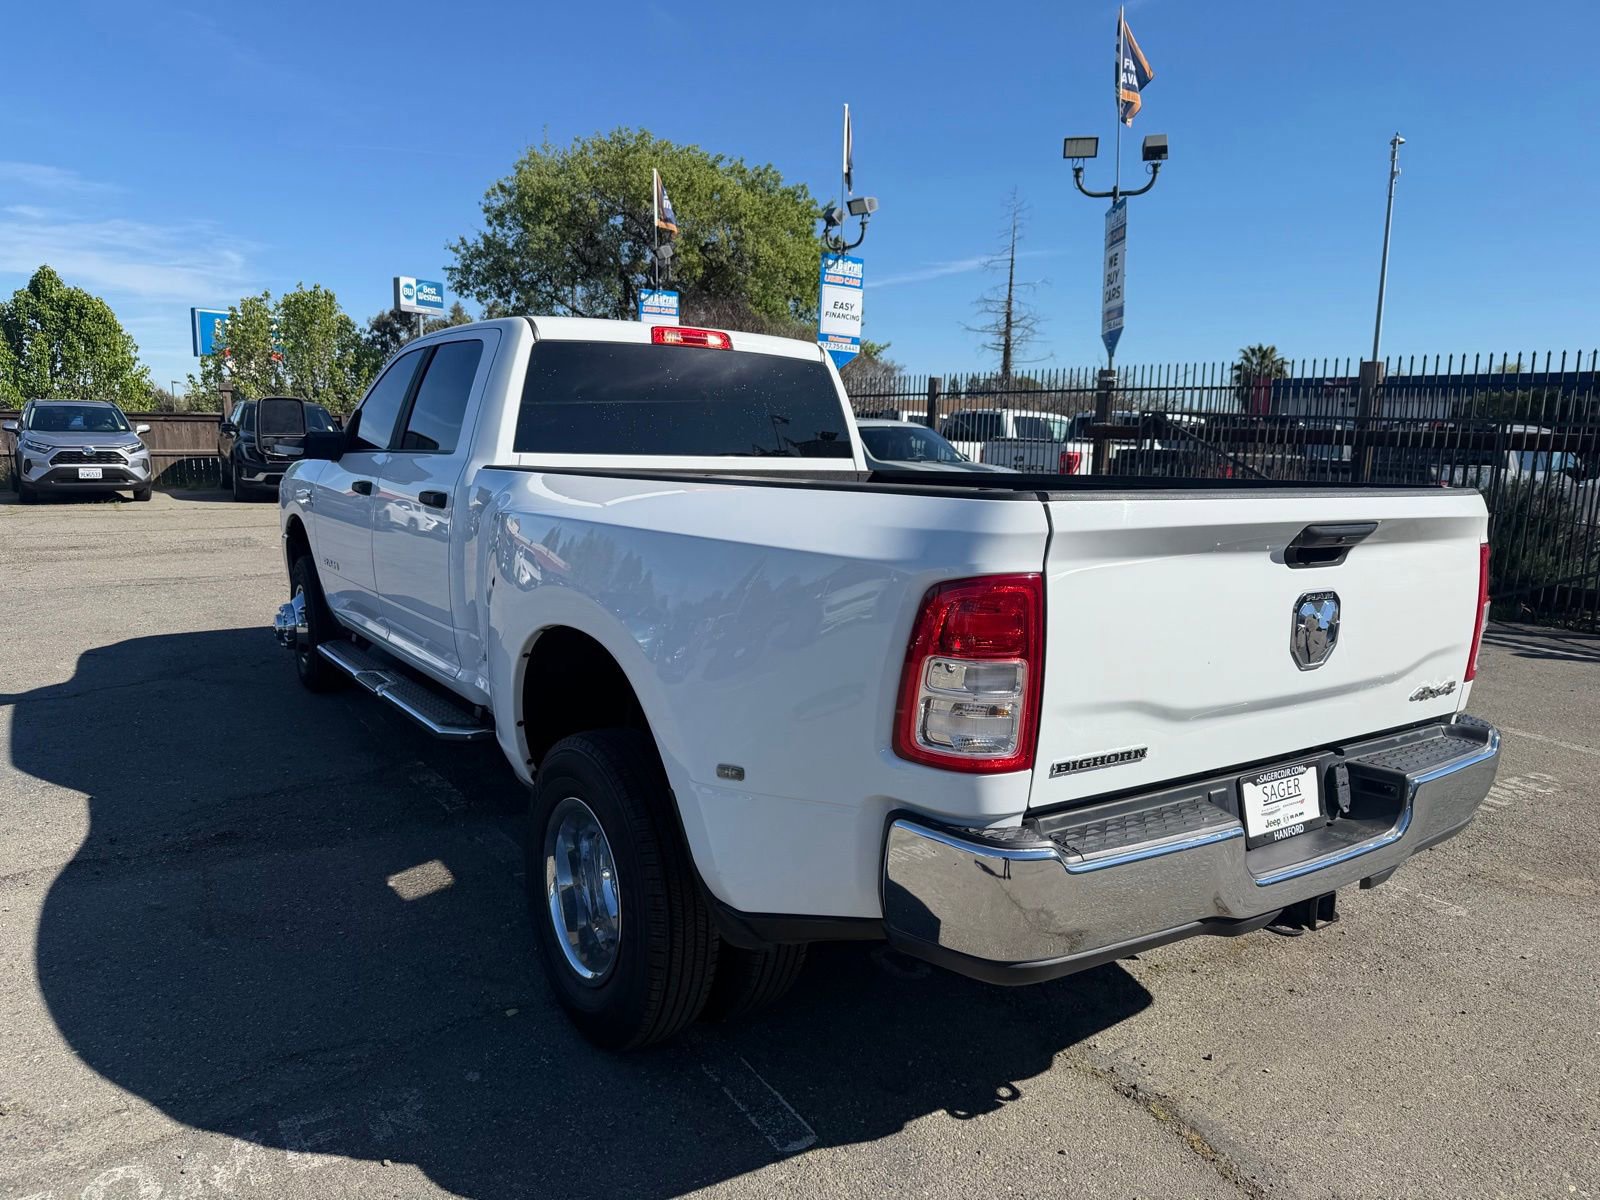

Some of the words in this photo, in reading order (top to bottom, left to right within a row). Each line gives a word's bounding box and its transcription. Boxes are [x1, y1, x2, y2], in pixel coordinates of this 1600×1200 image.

[1108, 253, 1119, 269] WE
[1106, 269, 1120, 287] BUY
[417, 292, 442, 303] Western
[422, 286, 437, 295] Best
[1105, 286, 1121, 304] CARS
[833, 301, 855, 312] EASY
[824, 311, 860, 322] FINANCING
[1049, 747, 1148, 779] BIGHORN
[1262, 777, 1302, 803] SAGER
[1265, 818, 1282, 829] Jeep
[1290, 811, 1305, 820] RAM
[1274, 824, 1304, 841] HANFORD
